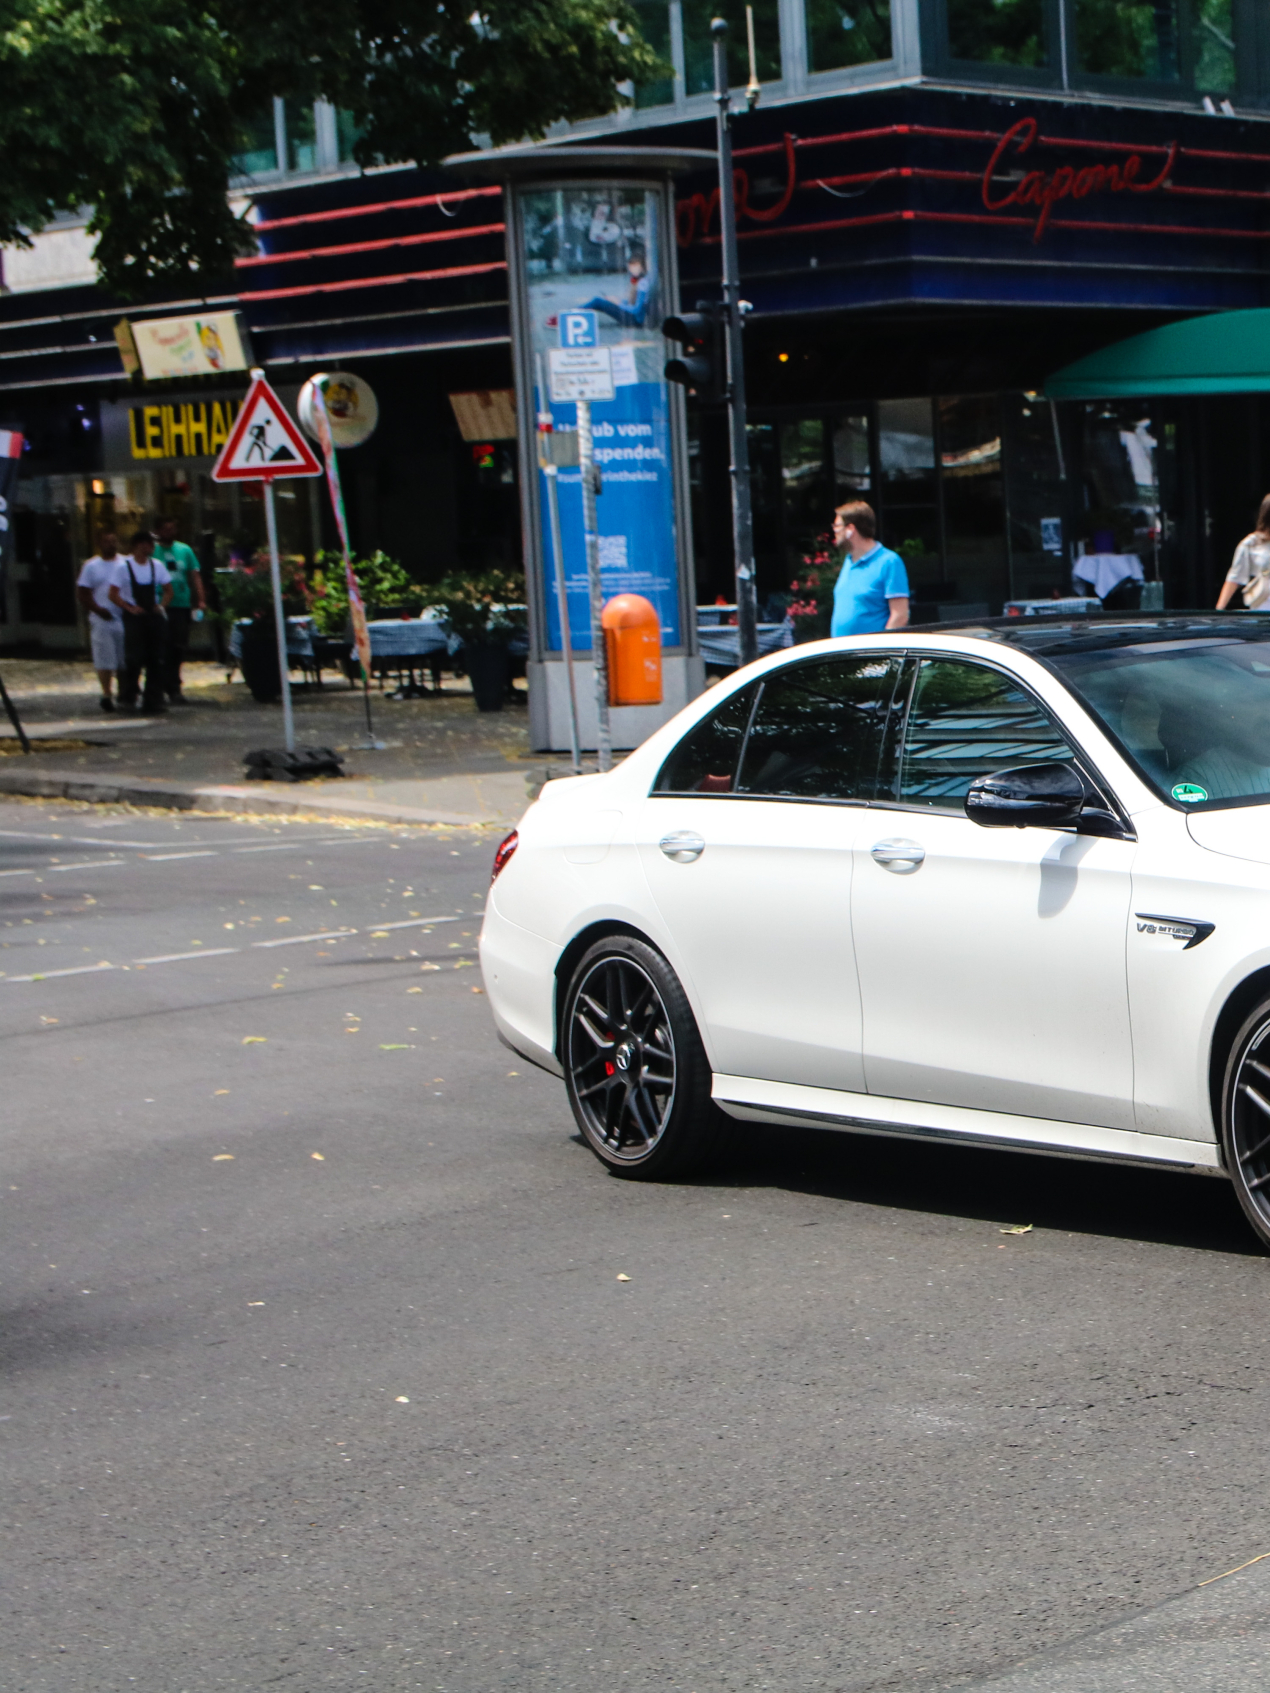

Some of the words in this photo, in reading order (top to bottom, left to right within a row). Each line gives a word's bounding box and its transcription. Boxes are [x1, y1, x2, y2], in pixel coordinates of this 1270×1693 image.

[983, 117, 1177, 244] Capone
[566, 315, 588, 346] P
[617, 423, 652, 437] vom
